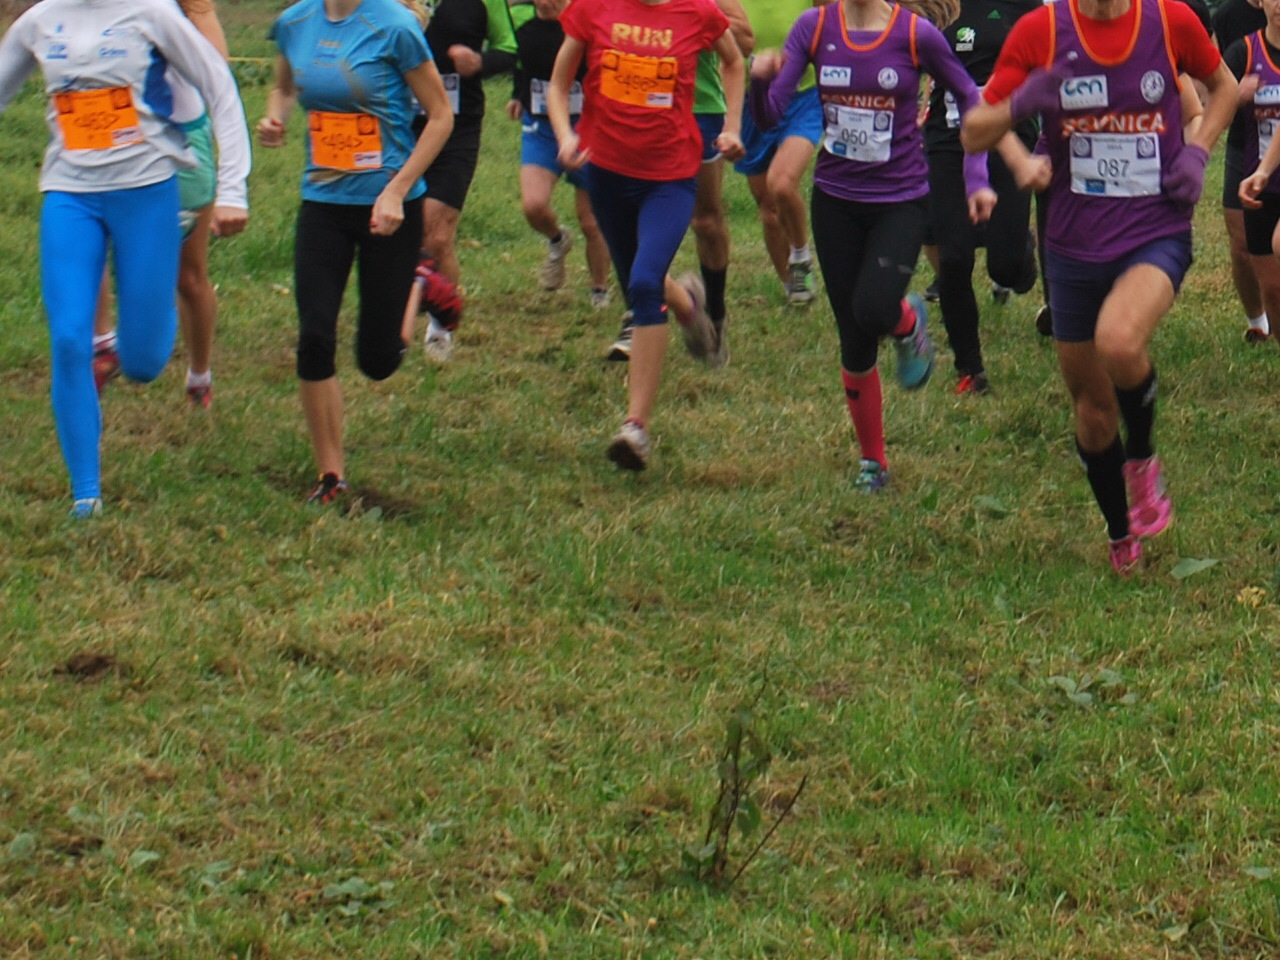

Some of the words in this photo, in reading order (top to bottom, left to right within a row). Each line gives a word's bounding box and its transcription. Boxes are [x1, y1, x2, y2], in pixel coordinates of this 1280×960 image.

[611, 23, 673, 50] RUN
[841, 128, 868, 146] 050
[1097, 158, 1130, 178] 087
